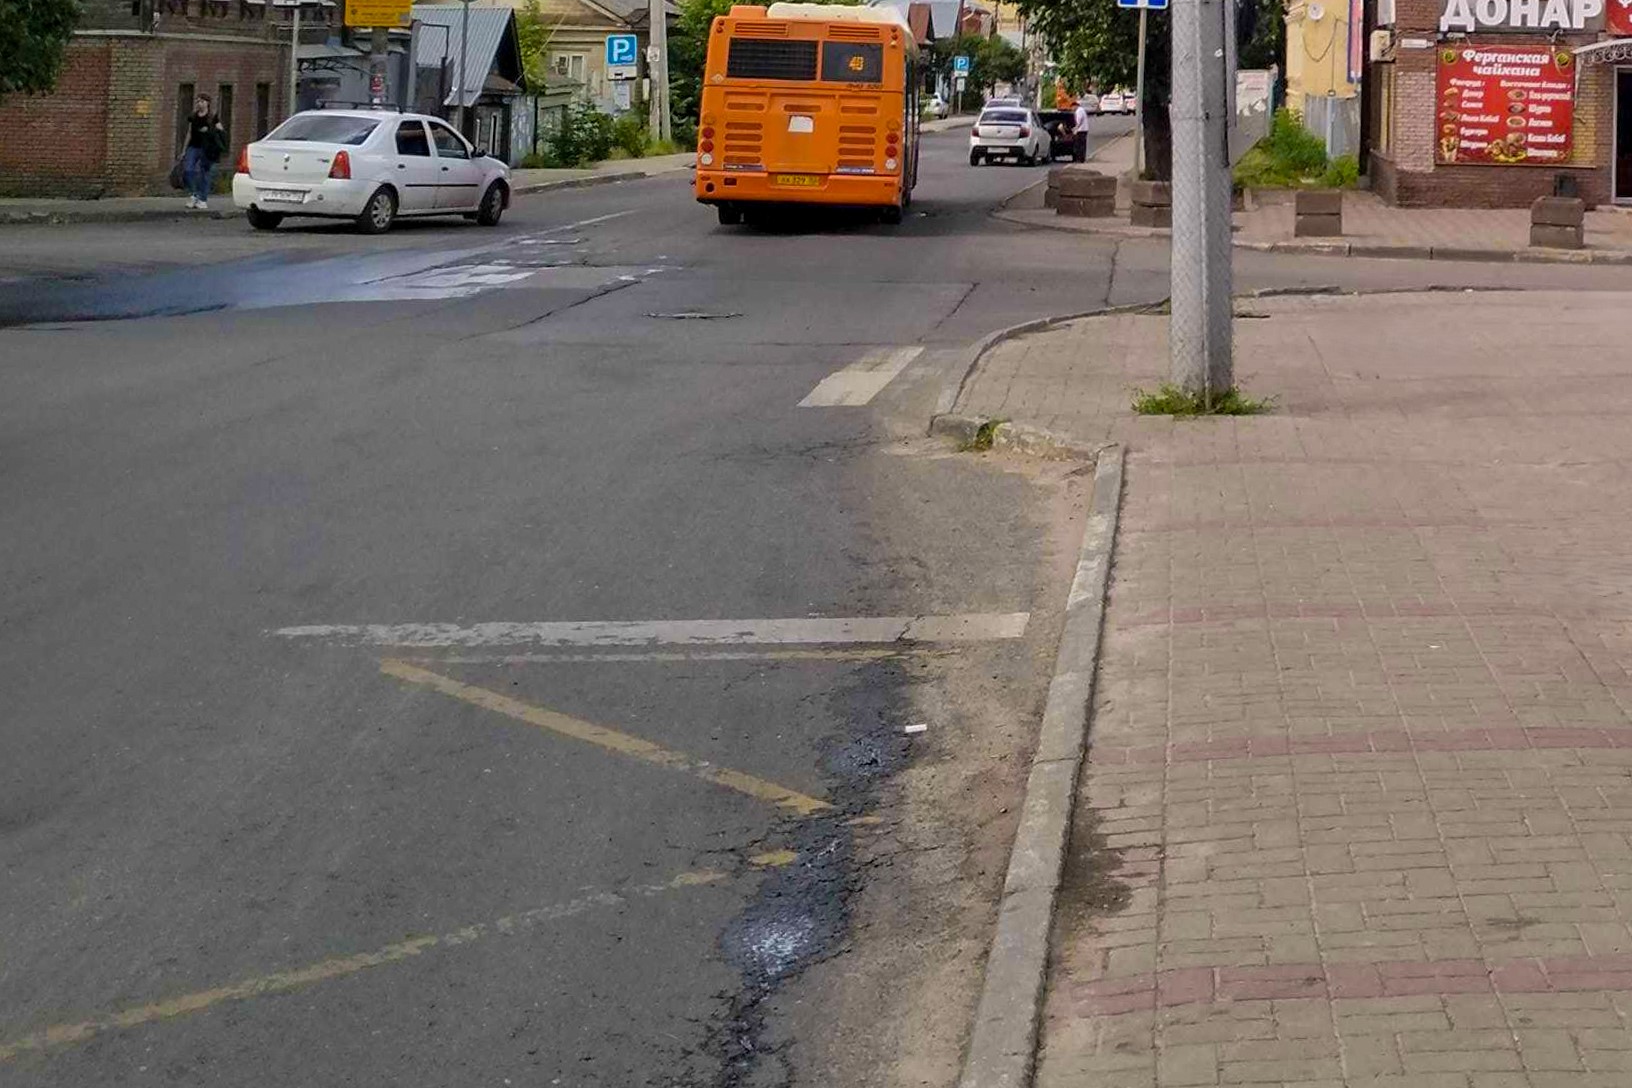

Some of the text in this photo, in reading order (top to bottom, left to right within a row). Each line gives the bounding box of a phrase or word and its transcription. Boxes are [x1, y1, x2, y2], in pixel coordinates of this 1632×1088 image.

[613, 38, 631, 62] P
[1462, 49, 1550, 65] Ферганская
[1472, 64, 1541, 76] чайхана
